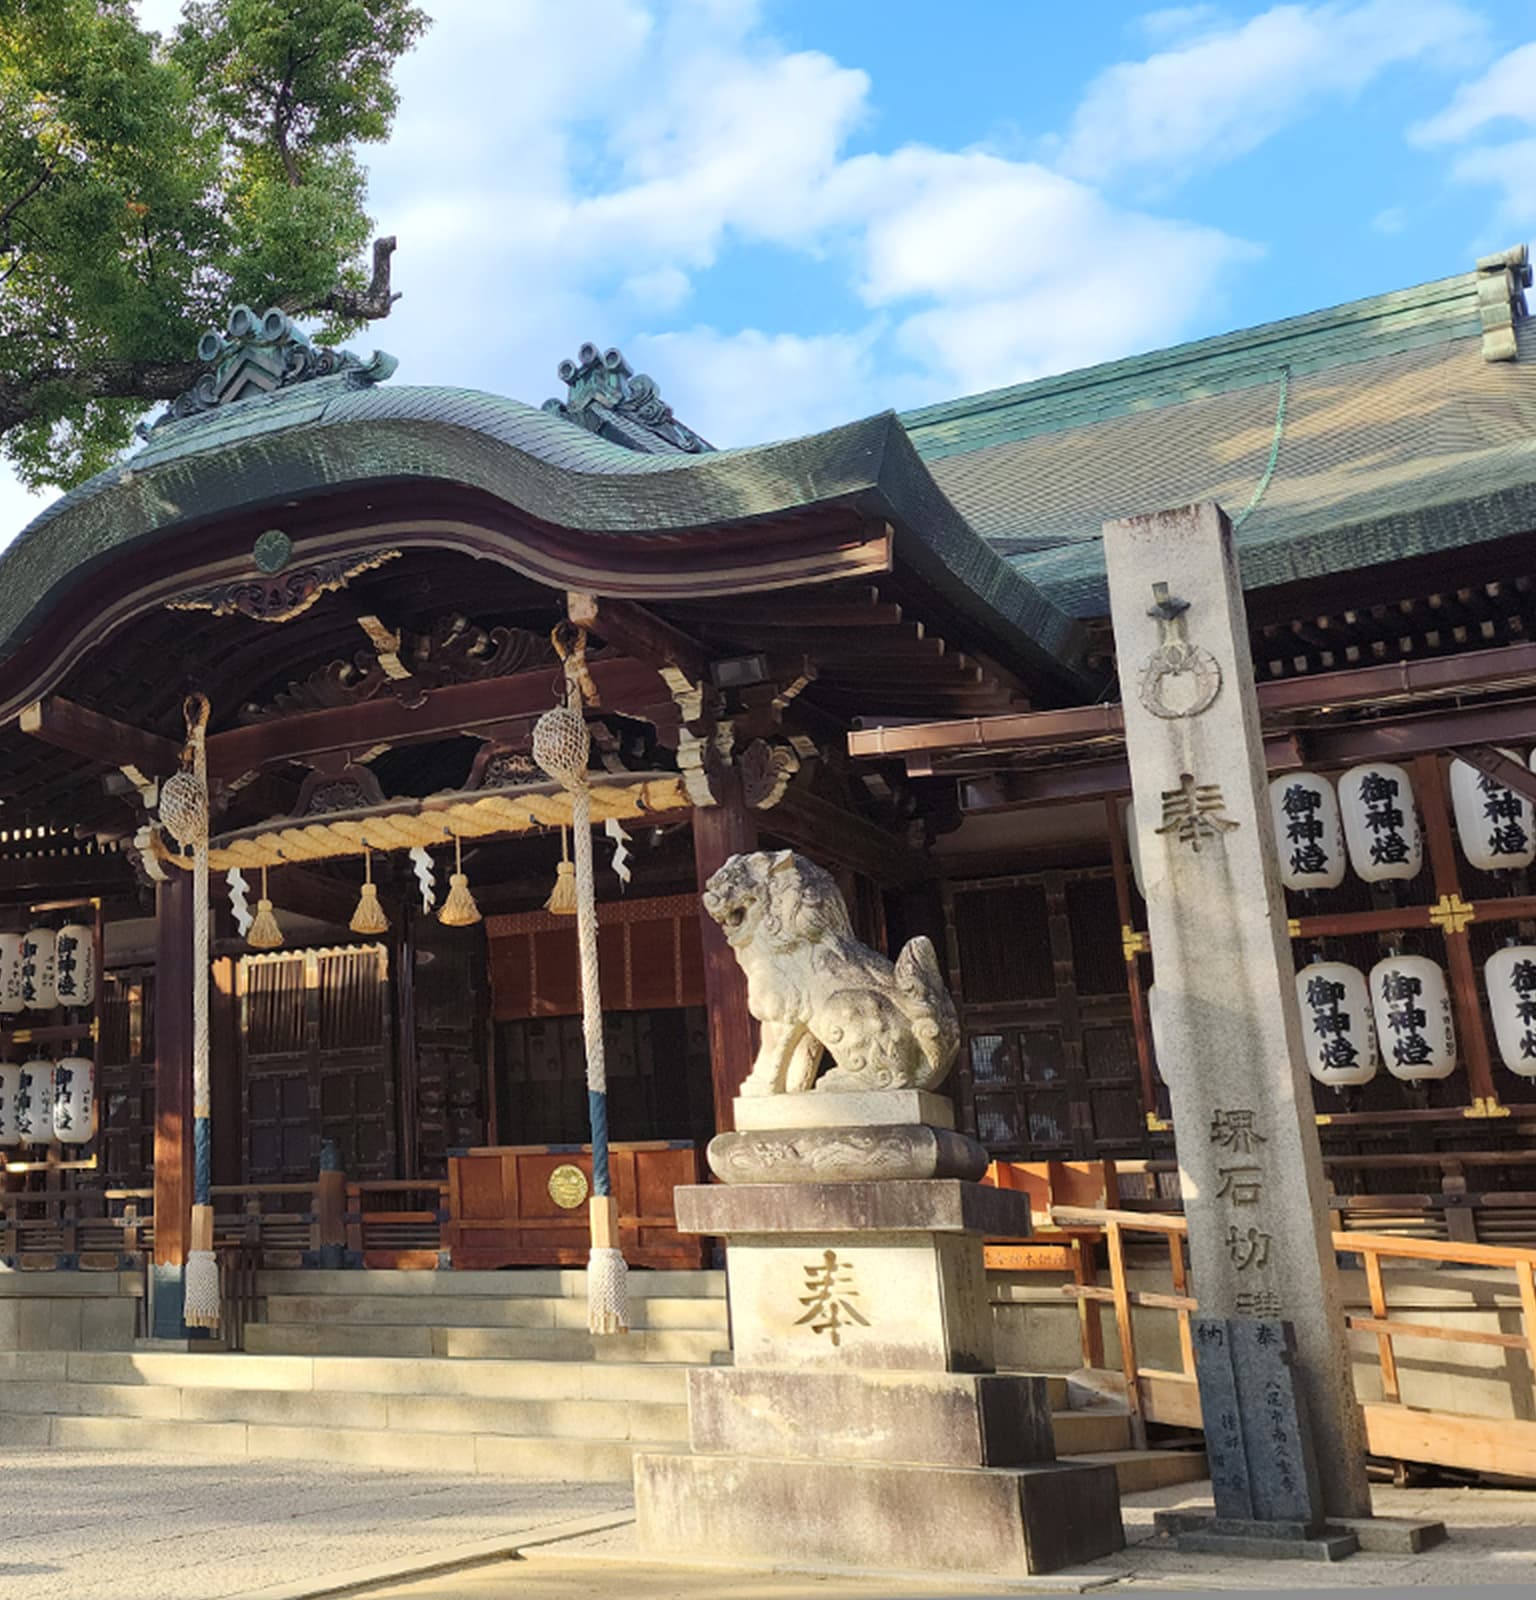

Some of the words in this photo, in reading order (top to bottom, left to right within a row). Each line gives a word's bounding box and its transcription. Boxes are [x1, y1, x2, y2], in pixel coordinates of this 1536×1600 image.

[1154, 773, 1240, 852] 奉
[1282, 783, 1329, 876] 御神燈
[1359, 771, 1410, 866] 御神燈
[1305, 975, 1359, 1070] 御神燈
[1382, 970, 1433, 1067] 御神燈
[794, 1249, 872, 1347] 奉
